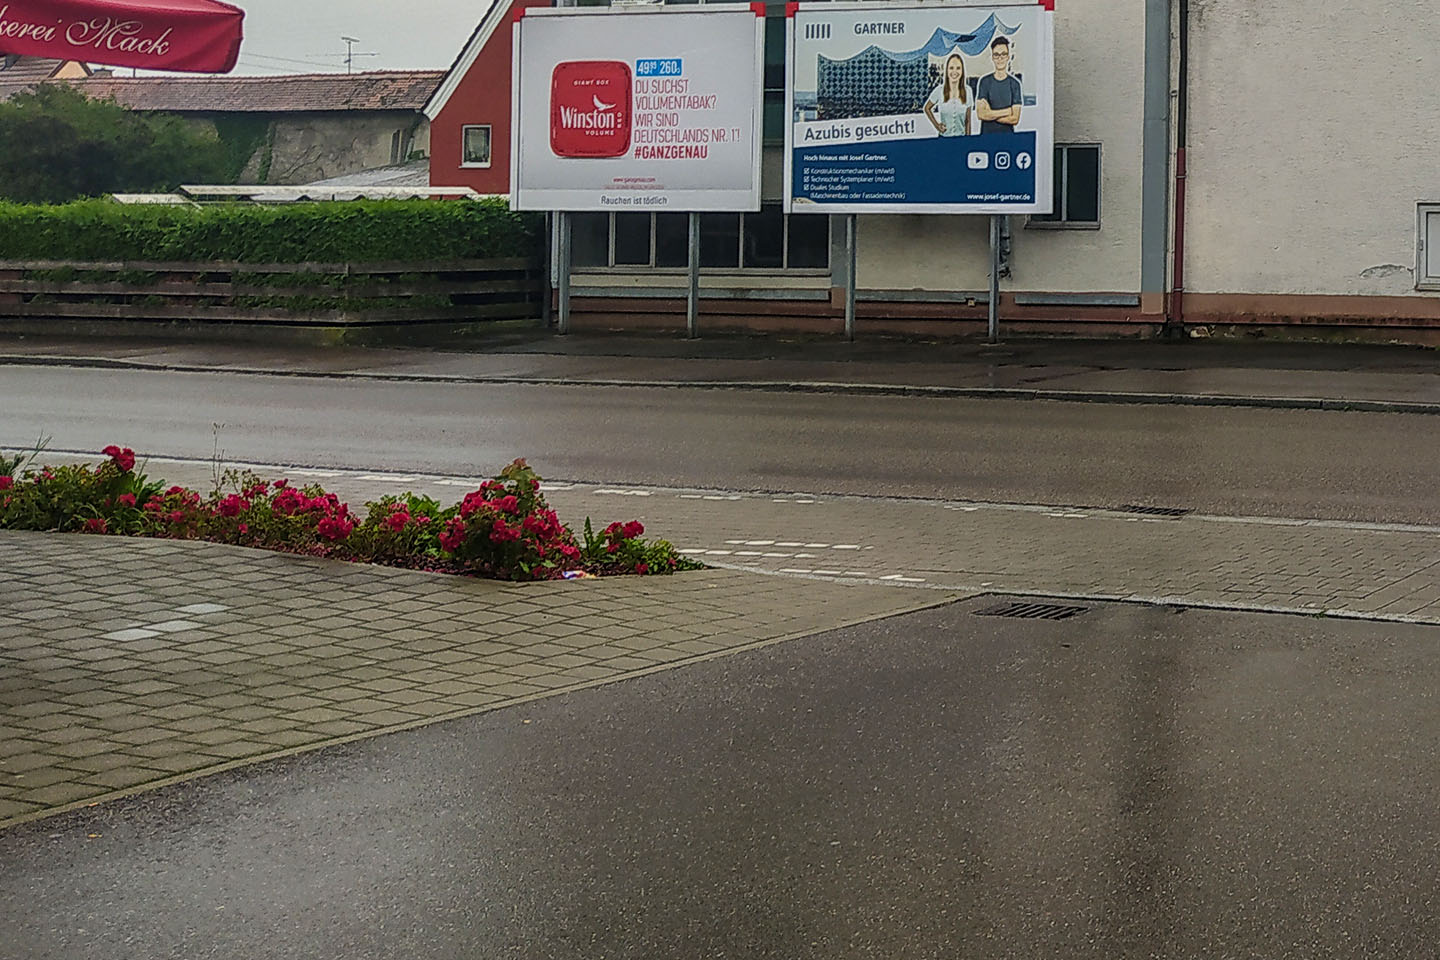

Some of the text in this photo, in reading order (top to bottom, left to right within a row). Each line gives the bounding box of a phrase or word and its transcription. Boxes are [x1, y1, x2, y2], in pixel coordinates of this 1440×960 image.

[65, 16, 173, 56] Mack
[854, 22, 905, 35] GARTNER
[635, 78, 689, 94] DU SUCHST
[635, 94, 717, 110] VOLUMENTABAK?
[560, 105, 615, 129] Winston
[634, 112, 679, 127] WIR SIND
[634, 128, 709, 144] DEUTSCHLANDS
[711, 128, 728, 142] NR.
[804, 119, 915, 140] Azubis gesucht!
[634, 145, 708, 159] #GANZGENAU
[600, 195, 668, 204] Rauchen ist tödlich
